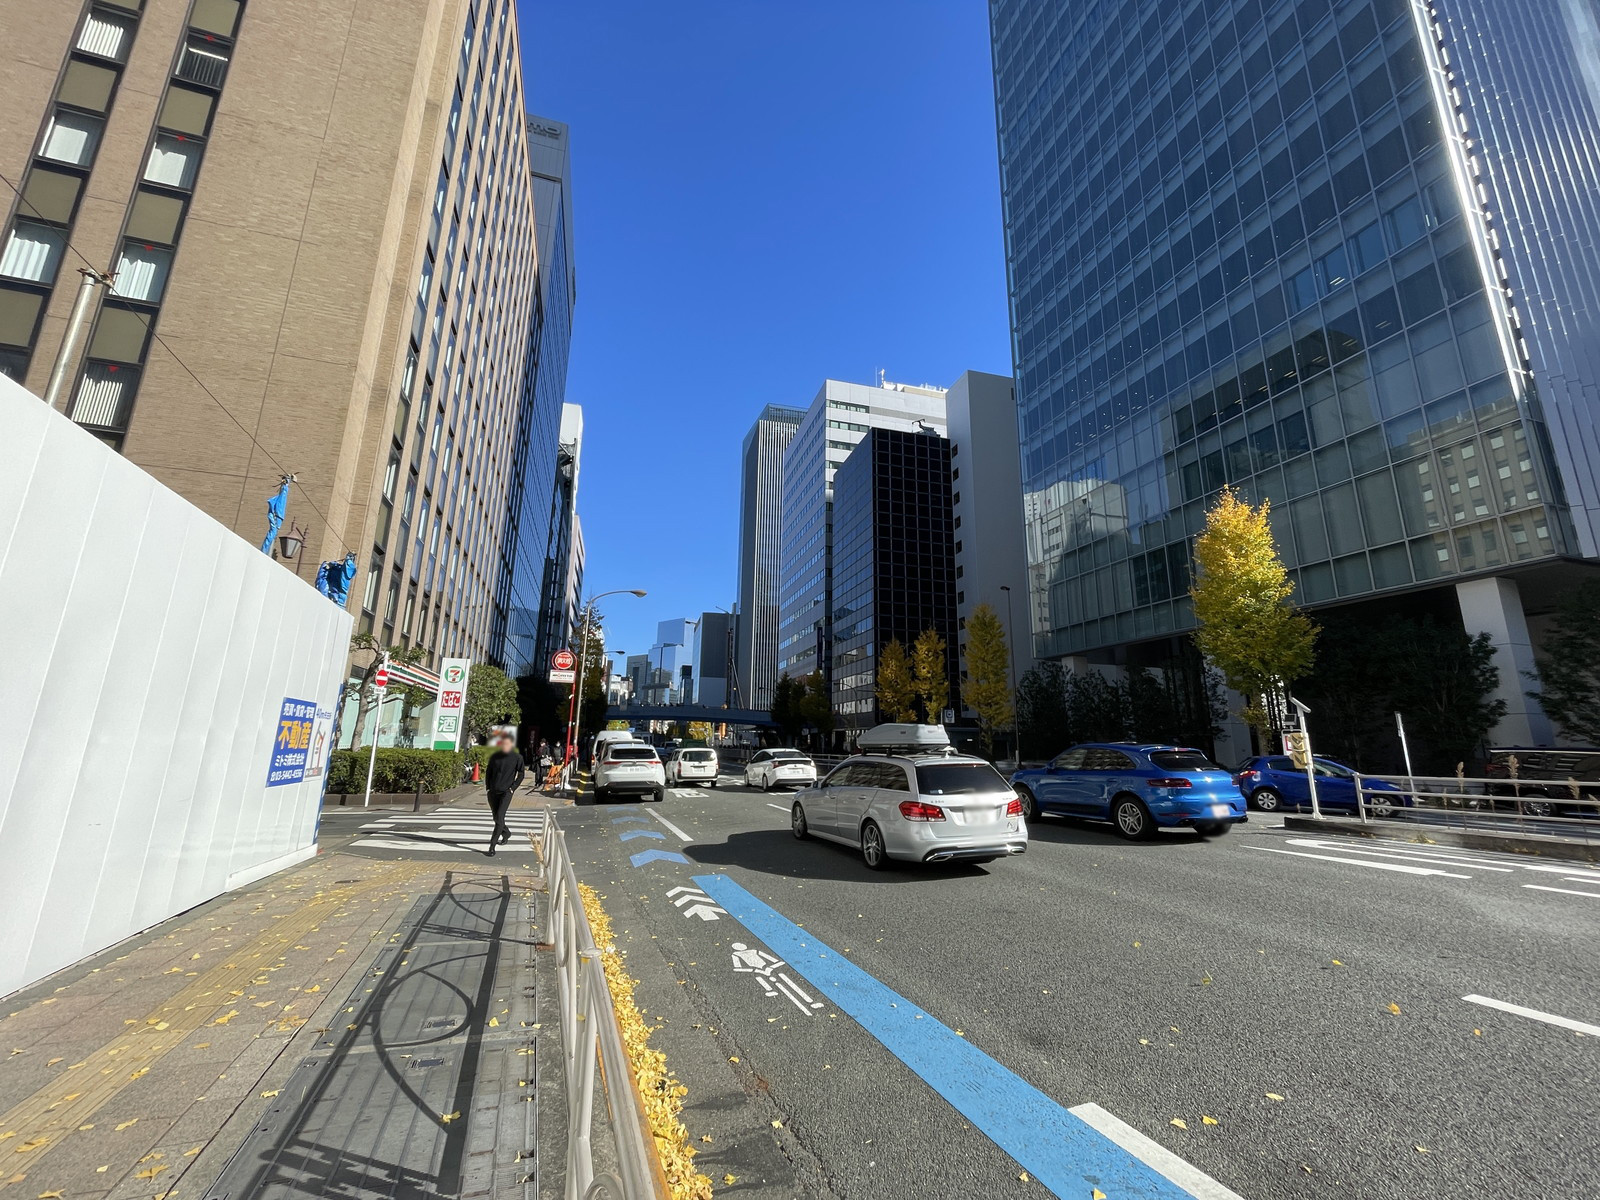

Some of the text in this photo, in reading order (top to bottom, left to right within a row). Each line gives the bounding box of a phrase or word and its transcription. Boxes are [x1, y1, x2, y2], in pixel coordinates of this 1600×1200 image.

[442, 692, 460, 707] たばこ
[438, 716, 456, 732] 酒
[279, 720, 312, 749] 不動産
[275, 753, 305, 767] ミトミ株式会社
